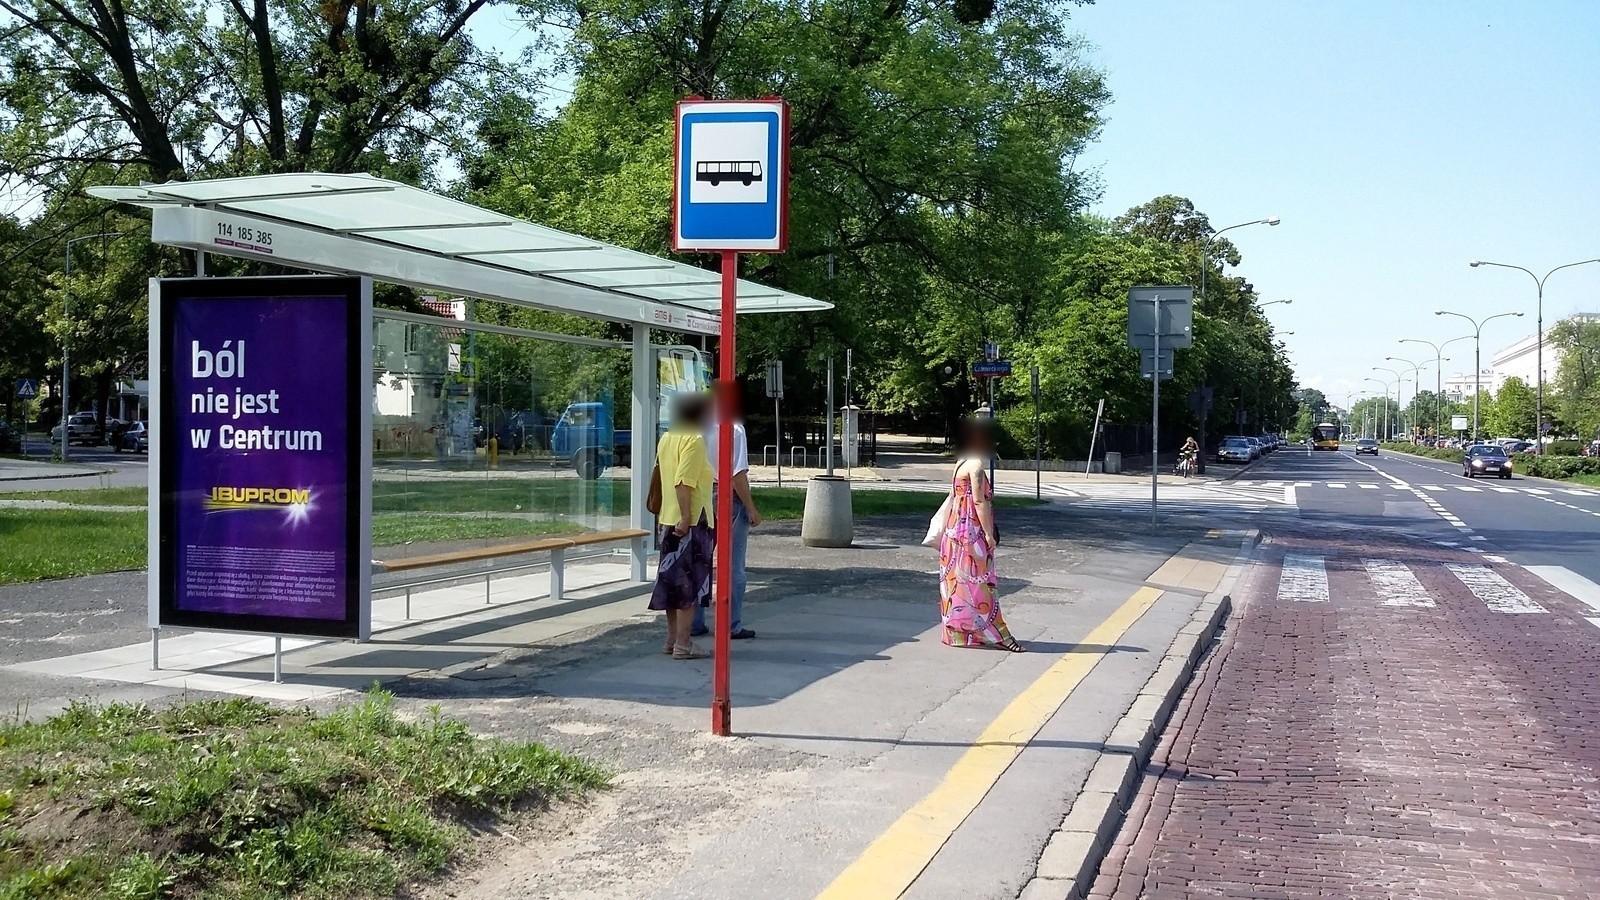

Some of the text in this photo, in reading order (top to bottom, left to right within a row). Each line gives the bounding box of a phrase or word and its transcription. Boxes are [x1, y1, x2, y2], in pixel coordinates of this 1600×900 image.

[217, 222, 273, 245] 114 185 385
[192, 340, 245, 378] ból
[191, 387, 280, 420] nie jest
[190, 424, 322, 451] w Centrum
[211, 486, 310, 504] IBUPROM
